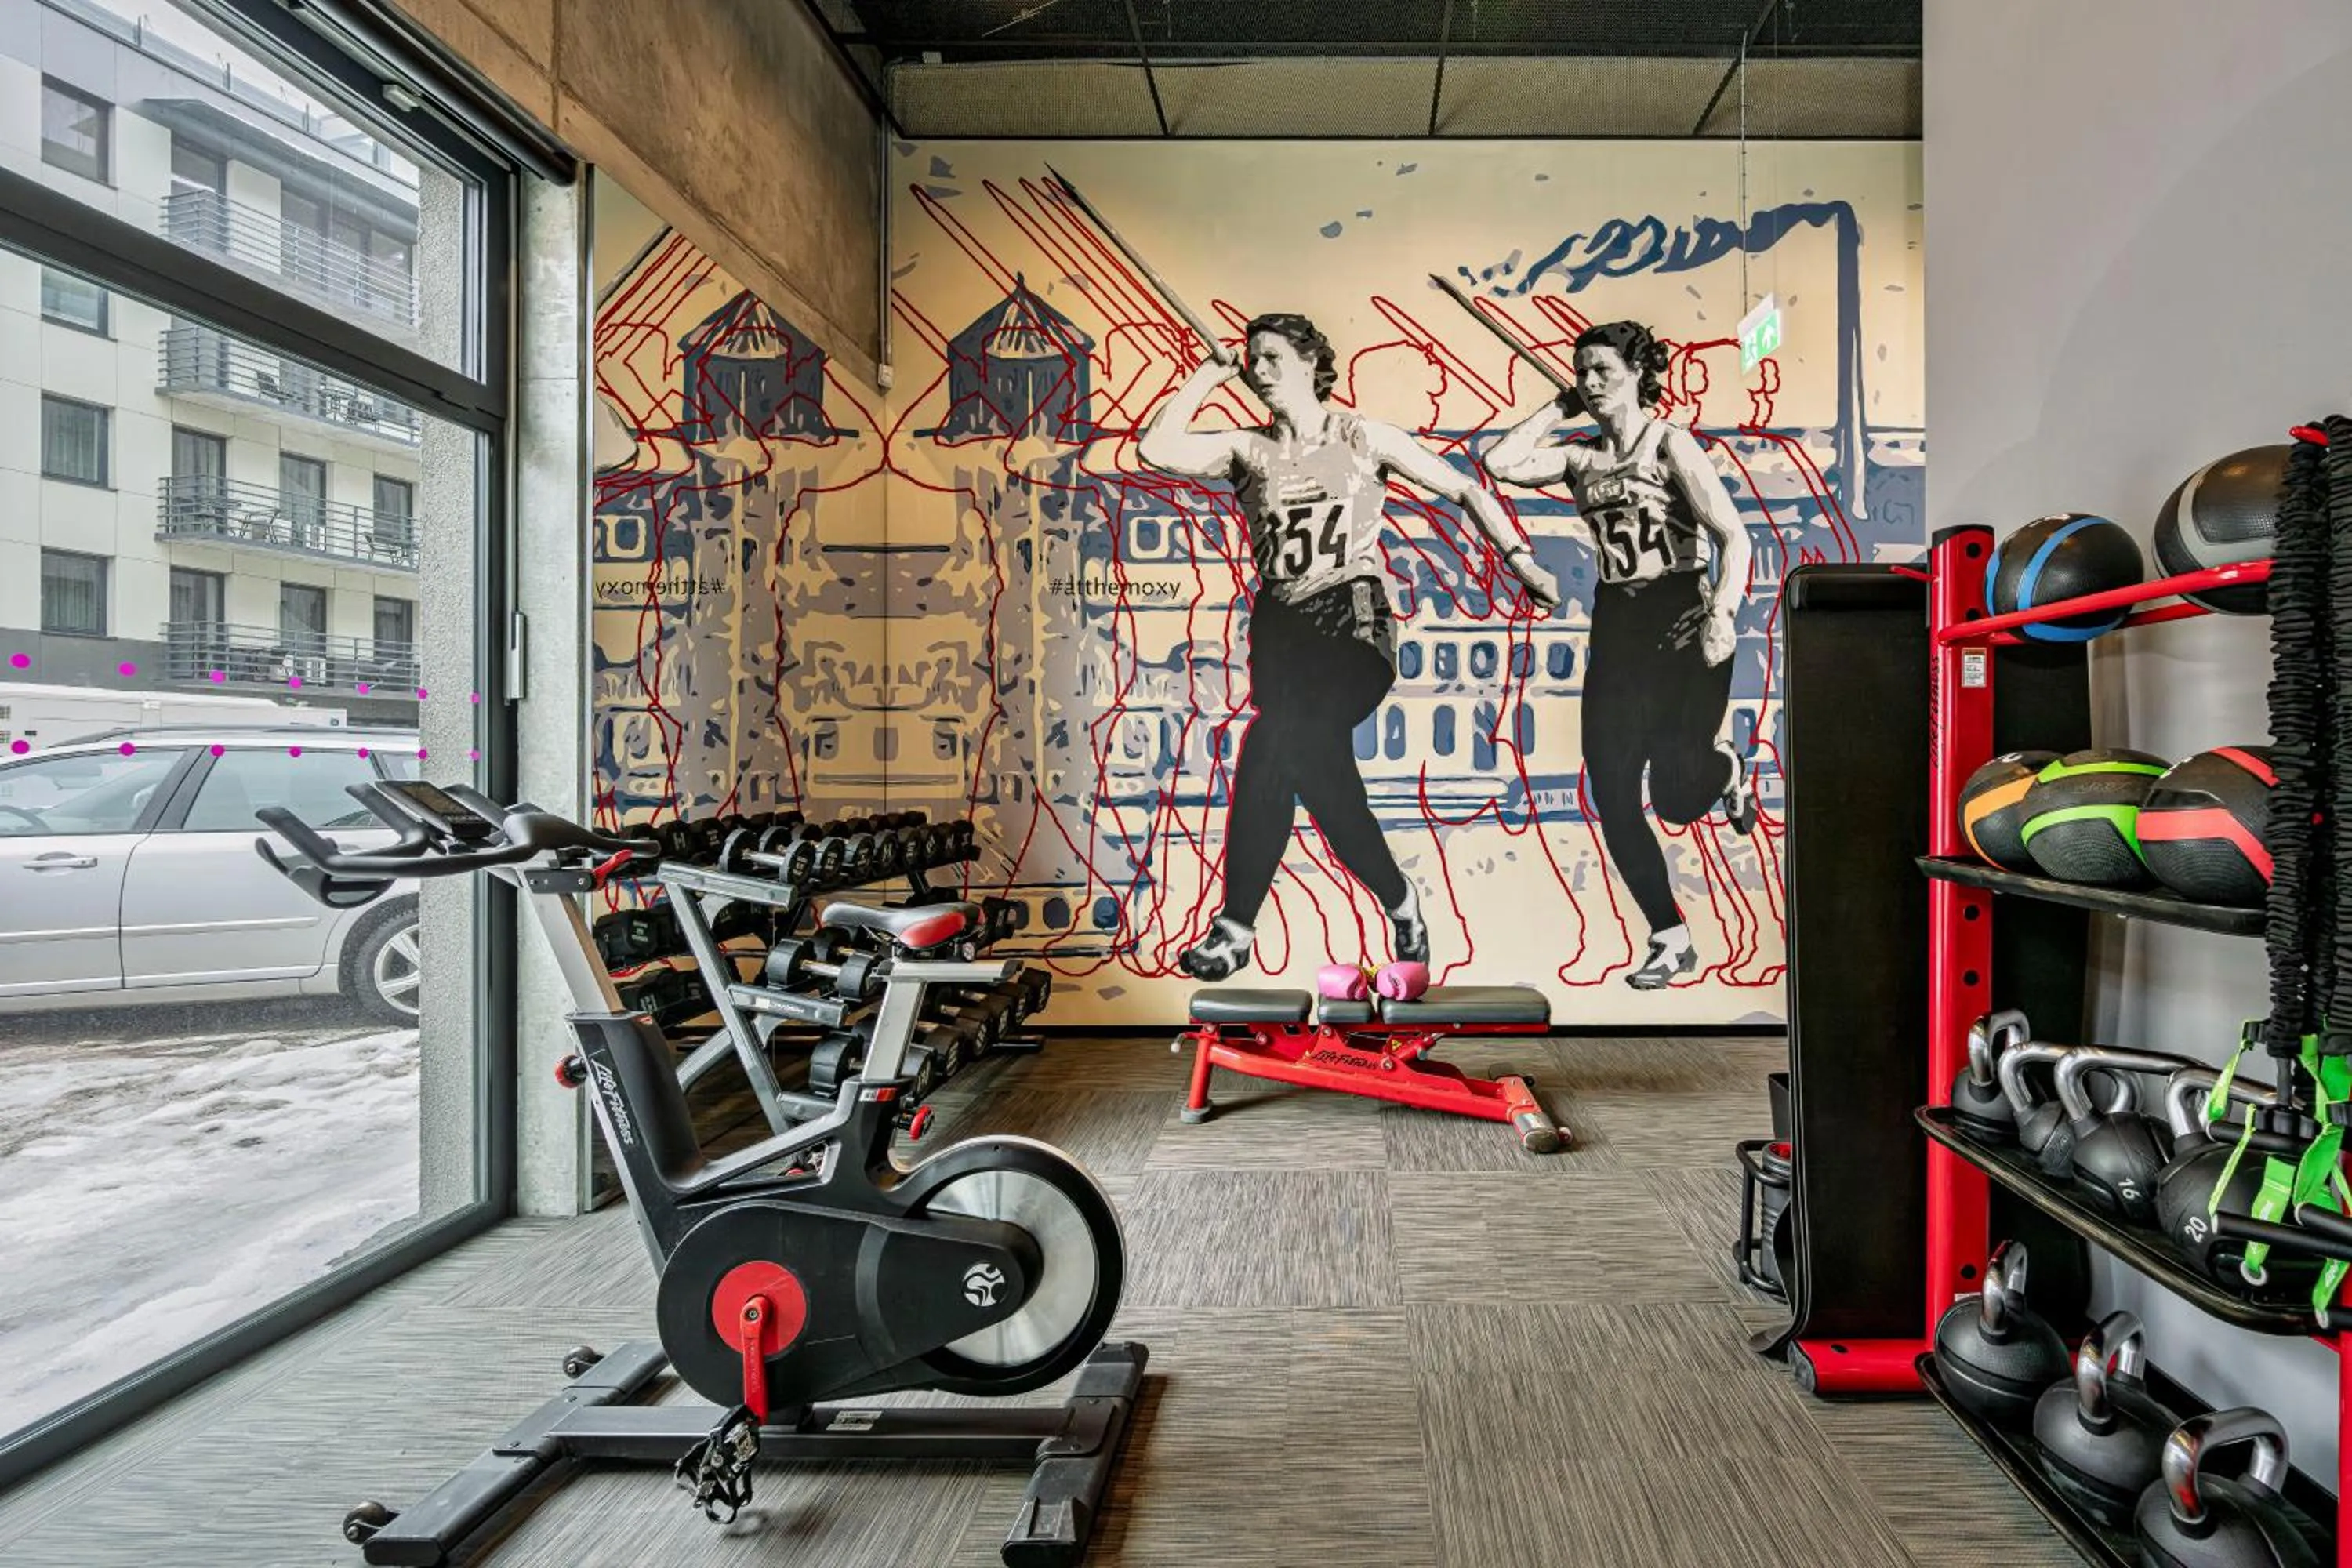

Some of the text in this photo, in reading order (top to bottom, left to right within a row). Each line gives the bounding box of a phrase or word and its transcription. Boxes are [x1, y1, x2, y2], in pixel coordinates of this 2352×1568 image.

[1591, 506, 1672, 580] 154
[1050, 575, 1181, 600] #atthemoxy
[590, 1058, 634, 1145] Life Fitness
[2118, 1178, 2142, 1200] 16
[2184, 1216, 2209, 1243] 20
